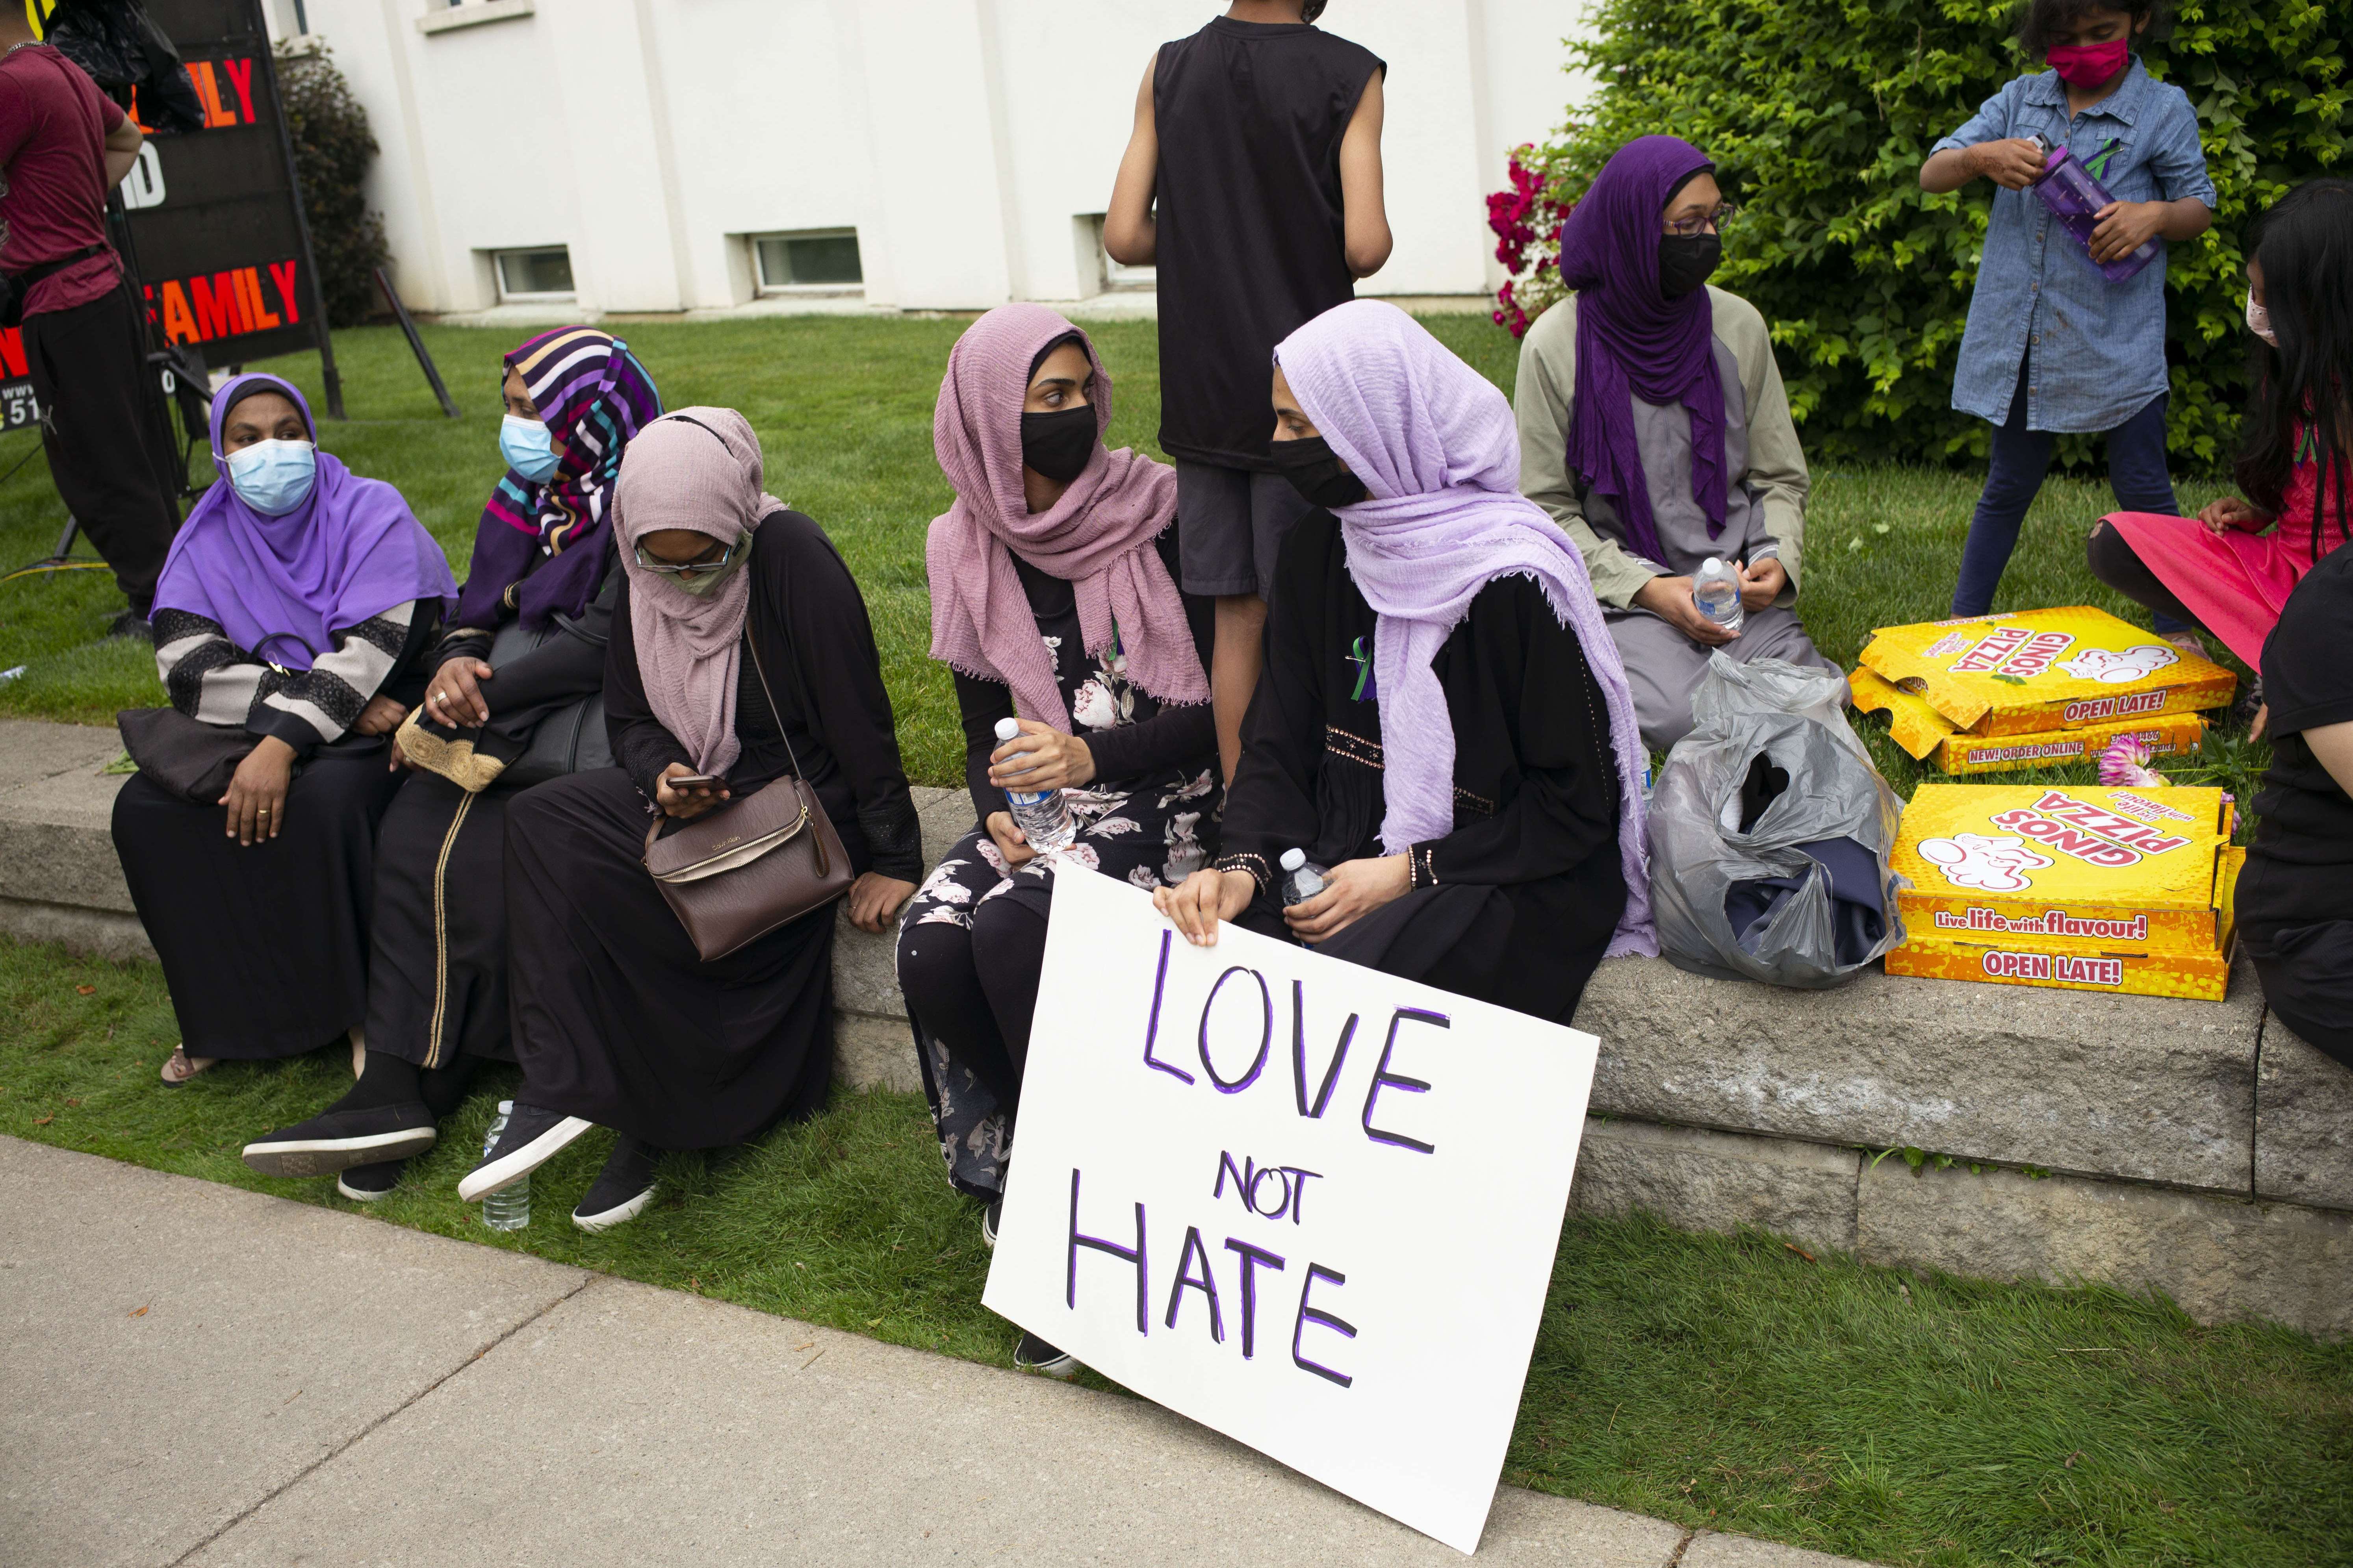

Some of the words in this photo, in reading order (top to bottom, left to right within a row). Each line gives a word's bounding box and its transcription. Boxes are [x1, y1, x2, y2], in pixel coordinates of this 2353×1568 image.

[1953, 628, 2029, 670] PIZZA
[2065, 700, 2113, 720] OPEN
[2118, 692, 2164, 714] LATE!
[1970, 749, 1999, 761] NEW!
[2002, 746, 2039, 758] ORDER
[2043, 741, 2082, 754] ONLINE
[2037, 793, 2184, 853] PIZZA
[1937, 913, 1967, 927] Live
[1969, 909, 2006, 930] life
[2010, 919, 2044, 933] with
[2046, 912, 2146, 938] flavour!
[1985, 953, 2048, 978] OPEN
[2057, 958, 2120, 984] LATE!
[1143, 929, 1451, 1154] LOVE
[1213, 1150, 1324, 1226] NOT
[1066, 1168, 1358, 1389] HATE
